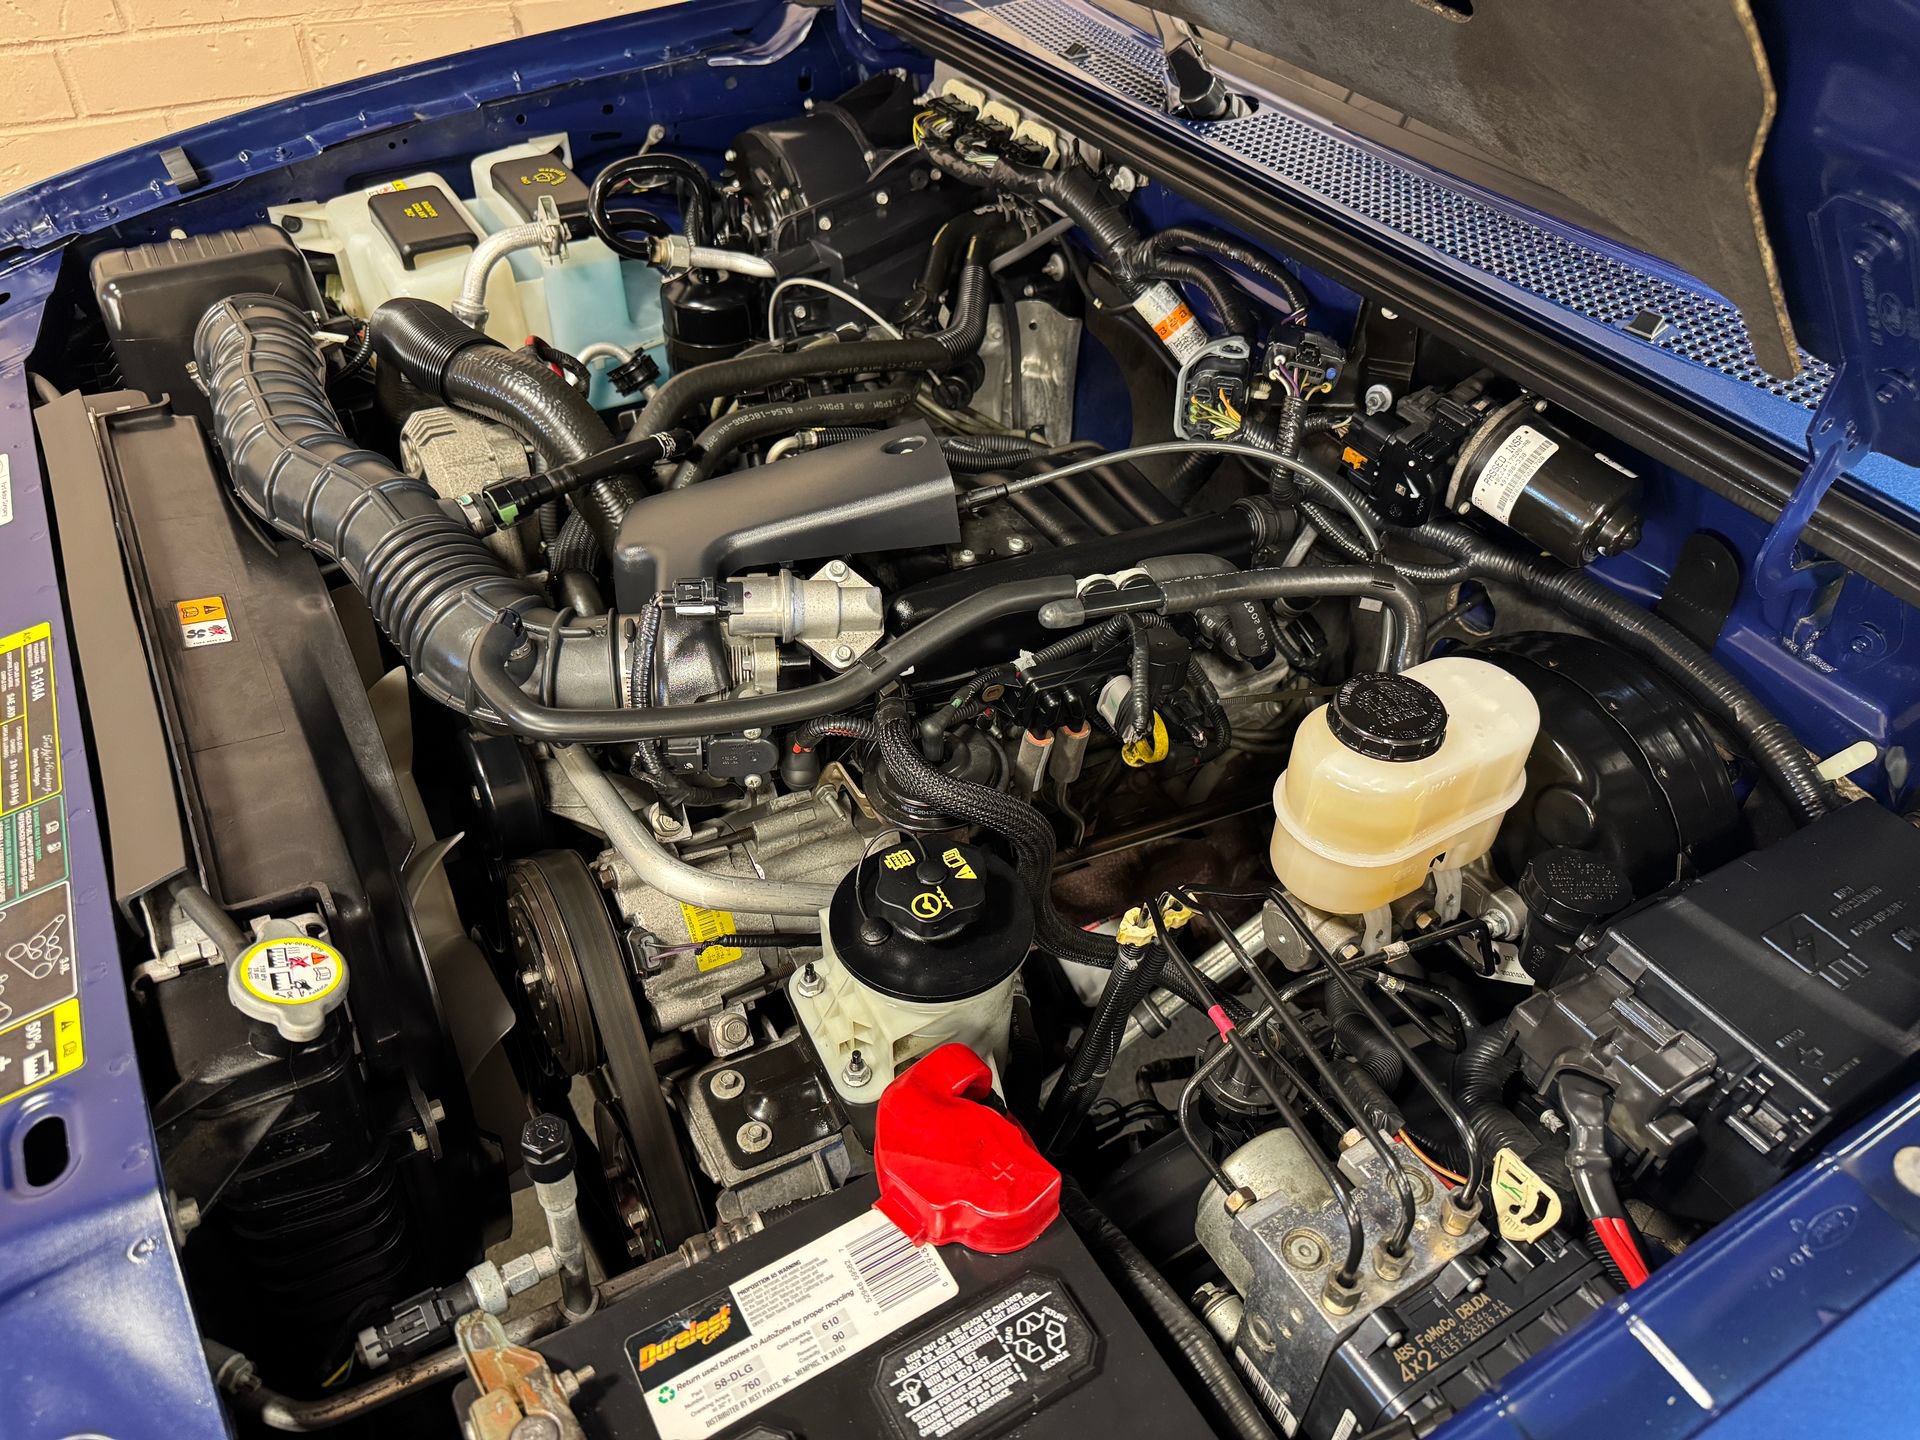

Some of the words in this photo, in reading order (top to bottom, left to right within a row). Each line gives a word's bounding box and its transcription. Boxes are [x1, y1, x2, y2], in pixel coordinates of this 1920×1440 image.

[1481, 454, 1508, 486] PASSED
[1505, 432, 1524, 454] INSP
[29, 666, 45, 701] R-134A
[20, 1019, 46, 1051] 50%
[736, 1276, 770, 1296] PROPOSITION
[769, 1271, 778, 1280] 65
[777, 1259, 801, 1275] WARNING
[820, 1315, 840, 1331] 610
[904, 1349, 923, 1363] KEEP
[922, 1341, 937, 1353] OUT
[936, 1334, 949, 1346] OF
[947, 1327, 962, 1339] THE
[960, 1315, 983, 1331] REACH
[981, 1308, 994, 1320] OF
[991, 1292, 1024, 1313] CHILDREN
[1042, 1305, 1067, 1322] RETURN
[632, 1304, 737, 1370] Duralast
[675, 1373, 700, 1391] Return
[700, 1363, 719, 1377] used
[718, 1346, 751, 1368] batteries
[749, 1340, 759, 1351] to
[757, 1323, 791, 1346] AutoZone
[787, 1316, 803, 1328] for
[801, 1305, 825, 1323] proper
[823, 1288, 855, 1310] recycling
[830, 1329, 845, 1343] 90
[894, 1367, 907, 1378] DO
[906, 1359, 921, 1371] NOT
[934, 1342, 952, 1356] KEEP
[950, 1332, 970, 1346] VENT
[987, 1311, 1006, 1325] TIGHT
[1004, 1303, 1020, 1315] AND
[1005, 1327, 1013, 1343] LEAD
[1392, 1341, 1416, 1364] ABS
[1414, 1314, 1456, 1348] FoMoCo
[918, 1362, 941, 1379] FLUSH
[939, 1352, 958, 1367] EYES
[954, 1330, 997, 1358] IMMEDIATELY
[923, 1373, 942, 1388] WITH
[963, 1352, 979, 1365] GET
[1039, 1349, 1071, 1371] RECYCLE
[704, 1402, 741, 1427] DISTRIBUTED
[738, 1397, 749, 1408] BY
[746, 1390, 763, 1403] BEST
[761, 1379, 782, 1396] PARTS,
[819, 1352, 831, 1364] TN
[712, 1362, 755, 1390] 58-DLG
[741, 1376, 762, 1393] 760
[927, 1376, 958, 1397] MEDICAL
[955, 1366, 974, 1381] HELP
[972, 1357, 990, 1370] FAST
[937, 1394, 952, 1407] FOR
[950, 1385, 968, 1399] SAFE
[966, 1376, 983, 1390] JUMP
[981, 1359, 1012, 1380] STARTING
[969, 1398, 978, 1407] IF
[976, 1391, 991, 1403] NOT
[988, 1373, 1021, 1394] AVAILABLE
[916, 1410, 942, 1428] FOLLOW
[939, 1385, 985, 1414] INSTRUCTIONS
[982, 1381, 991, 1390] IN
[988, 1367, 1014, 1385] VEHICLE
[934, 1423, 953, 1437] SEEK
[951, 1409, 976, 1427] SERVICE
